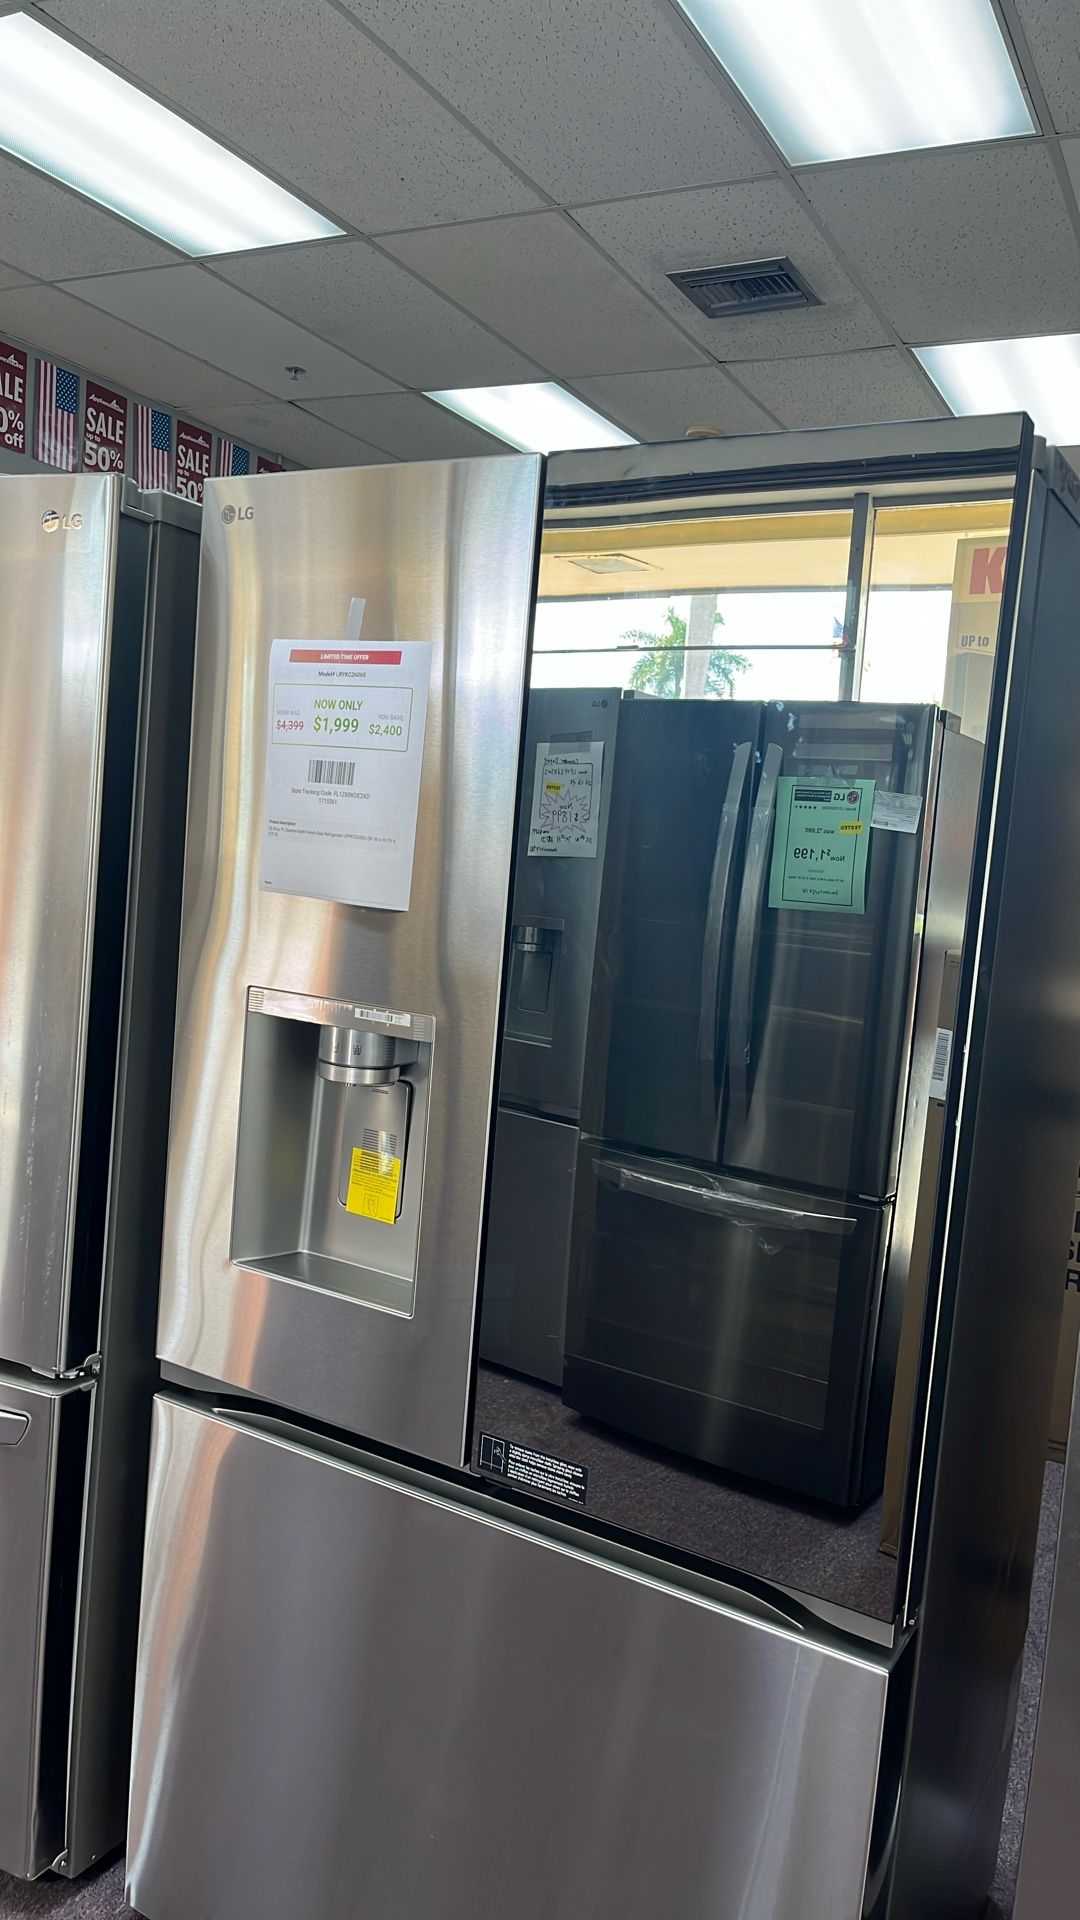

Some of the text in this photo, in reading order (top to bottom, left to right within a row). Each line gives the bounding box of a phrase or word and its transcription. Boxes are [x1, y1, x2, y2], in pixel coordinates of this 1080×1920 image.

[0, 372, 23, 404] LE
[86, 407, 124, 445] SALE
[5, 433, 24, 449] off
[86, 433, 101, 443] up to
[84, 440, 123, 471] 50%
[177, 444, 210, 477] SALE
[238, 506, 254, 520] LG
[62, 513, 82, 530] LG
[978, 636, 989, 647] to
[314, 699, 363, 711] NOW ONLY
[313, 714, 359, 735] $1,999
[390, 714, 403, 722] SAVE
[276, 719, 304, 732] $4,399
[369, 723, 402, 737] $2,400
[303, 788, 320, 796] Tracking
